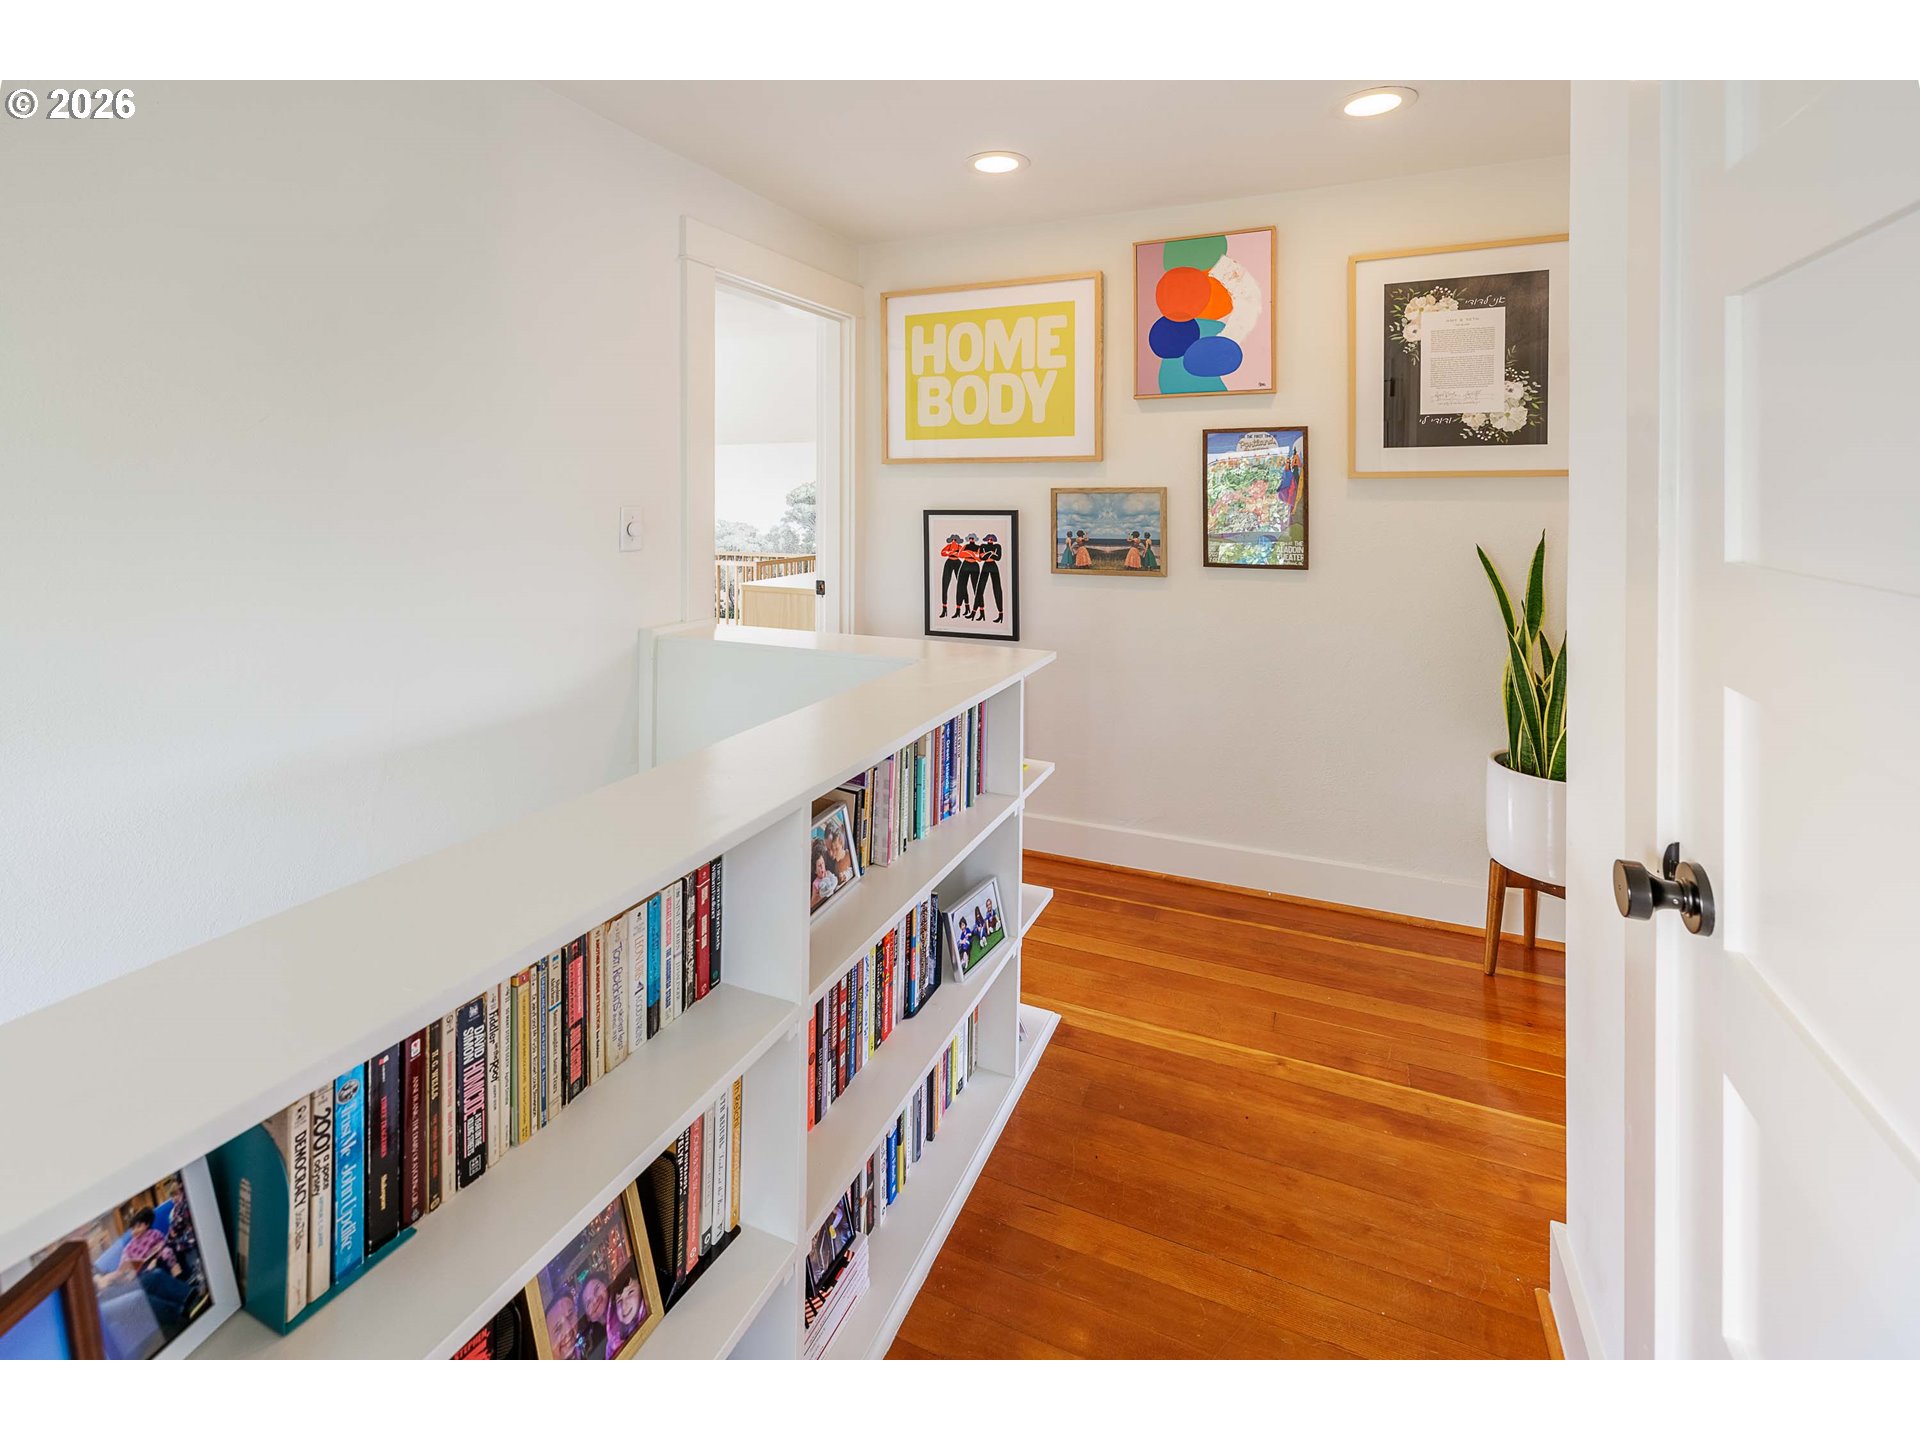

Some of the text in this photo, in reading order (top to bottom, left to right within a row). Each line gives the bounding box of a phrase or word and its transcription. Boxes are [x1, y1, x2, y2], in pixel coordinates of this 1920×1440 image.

[911, 305, 1068, 375] HOME
[917, 370, 1058, 427] BODY
[612, 942, 623, 1011] Tom Robbins
[463, 1027, 475, 1066] SIMON
[474, 1025, 485, 1059] DAVID
[489, 1008, 499, 1045] Fiddler
[431, 1069, 439, 1100] WELLS
[463, 1058, 485, 1121] HOMICIDE
[489, 1059, 500, 1083] Roof
[313, 1107, 331, 1158] 2001
[340, 1101, 358, 1157] Trust Me
[677, 1133, 685, 1166] VELYN
[294, 1130, 306, 1209] DEMOCRACY
[312, 1160, 321, 1197] odyssey
[322, 1163, 330, 1190] space
[336, 1164, 357, 1254] John Updike
